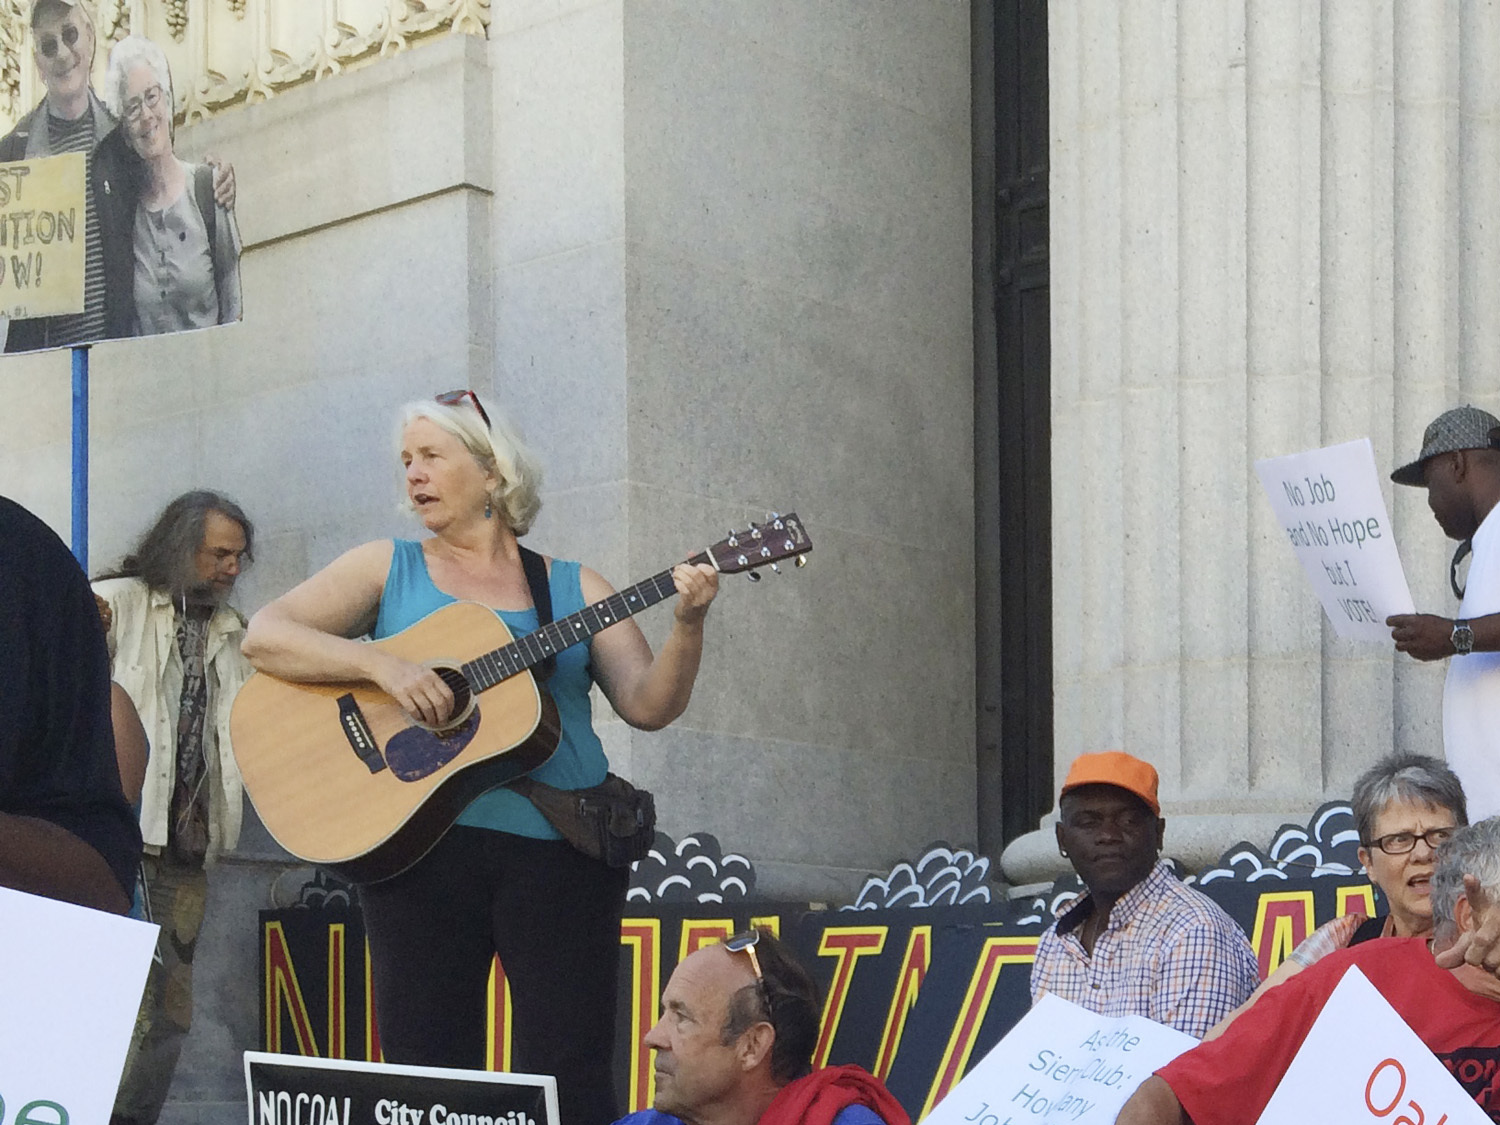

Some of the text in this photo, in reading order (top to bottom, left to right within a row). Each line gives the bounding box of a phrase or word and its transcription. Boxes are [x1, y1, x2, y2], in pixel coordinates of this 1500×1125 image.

[1282, 473, 1336, 507] No Job
[1286, 517, 1382, 549] and No Hope
[1321, 560, 1358, 586] but I
